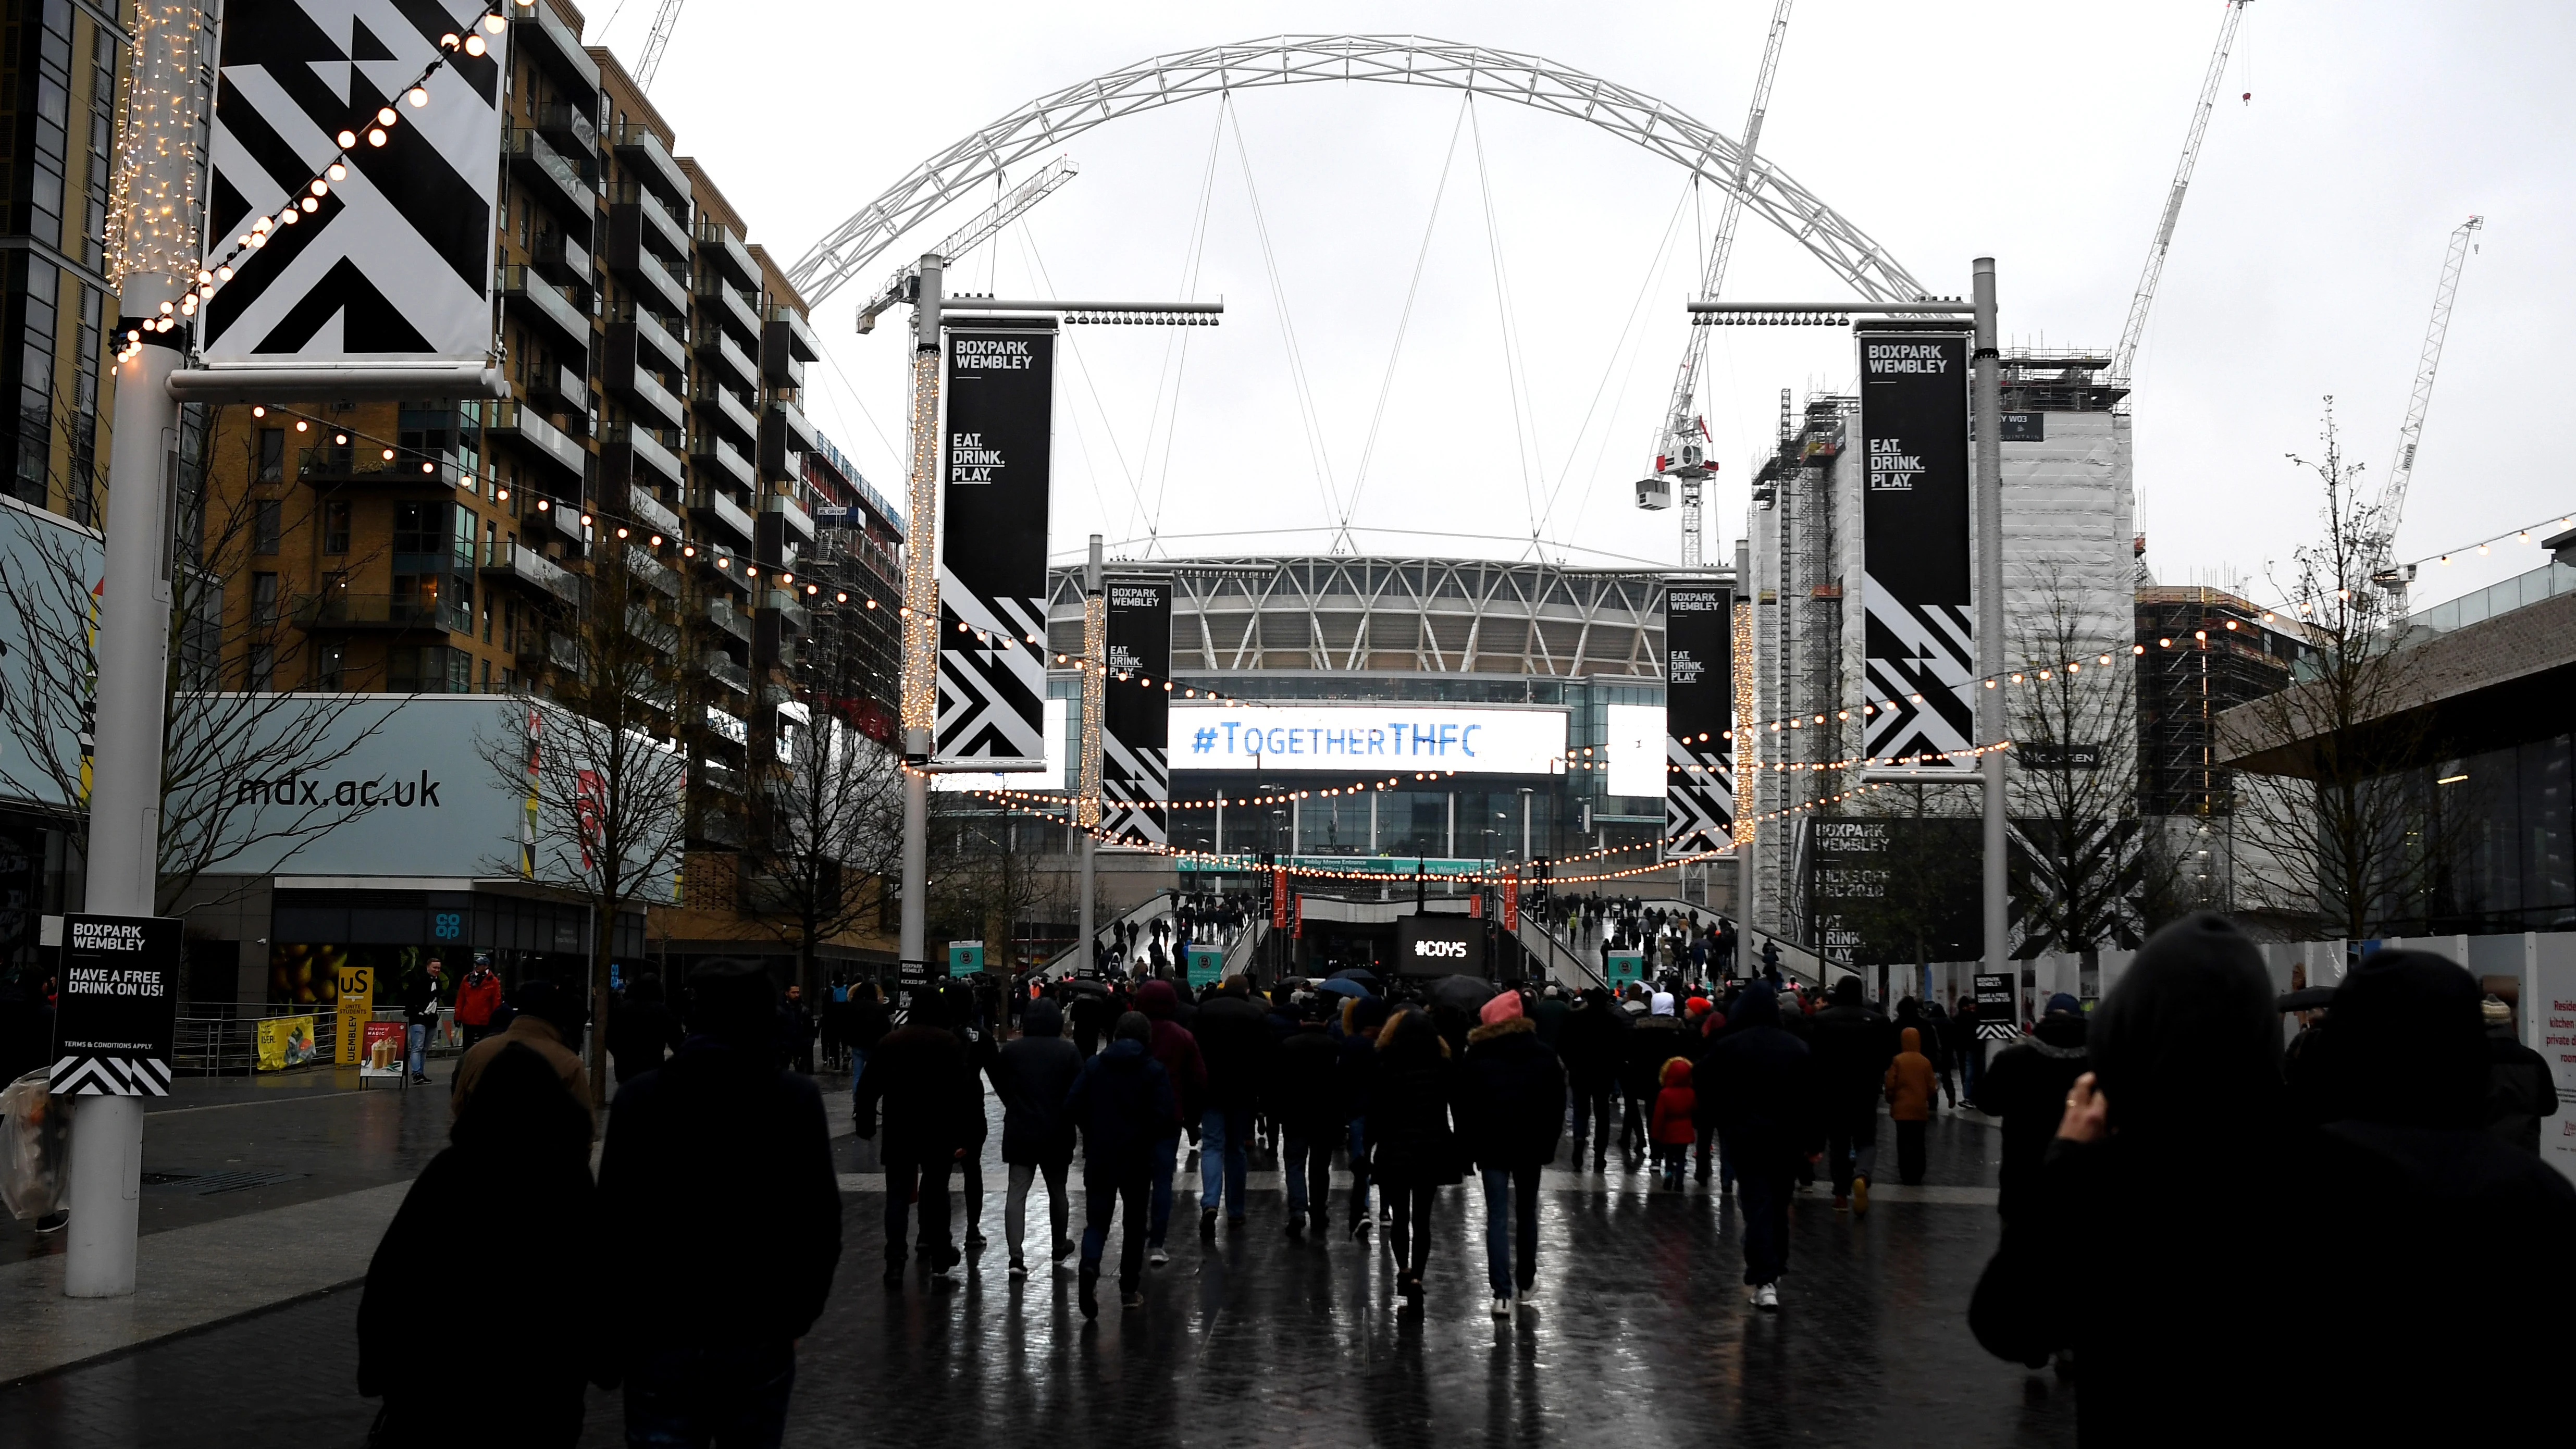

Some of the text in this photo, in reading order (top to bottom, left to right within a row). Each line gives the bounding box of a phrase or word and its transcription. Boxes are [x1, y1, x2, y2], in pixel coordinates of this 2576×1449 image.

[956, 340, 1029, 355] BOXPARK
[1868, 344, 1942, 359] BOXPARK
[956, 355, 1033, 369] WEMBLEY
[1868, 359, 1948, 374] WEMBLEY
[953, 433, 983, 447] EAT.
[1869, 438, 1902, 453] EAT.
[952, 450, 1006, 464] DRINK.
[1870, 456, 1926, 470] DRINK.
[952, 467, 992, 481] PLAY.
[1871, 473, 1913, 488] PLAY.
[1111, 588, 1157, 598] BOXPARK
[1670, 592, 1716, 601] BOXPARK
[1111, 597, 1160, 607] WEMBLEY
[1670, 602, 1719, 611] WEMBLEY
[1110, 646, 1129, 655] EAT.
[1670, 651, 1690, 660] EAT.
[1110, 657, 1143, 666] DRINK.
[1671, 661, 1705, 670] DRINK.
[1671, 672, 1696, 681] PLAY.
[237, 769, 440, 807] mdx.ac.uk
[1394, 864, 1416, 873] Level
[73, 923, 142, 938] BOXPARK
[73, 936, 146, 951] WEMBLEY
[1415, 940, 1467, 958] #COYS
[69, 968, 161, 984] HAVE A FREE
[68, 981, 164, 997] DRINK ON US!
[2550, 1017, 2574, 1028] kitchen
[347, 1015, 357, 1061] WEMBLEY
[2546, 1036, 2570, 1047] private
